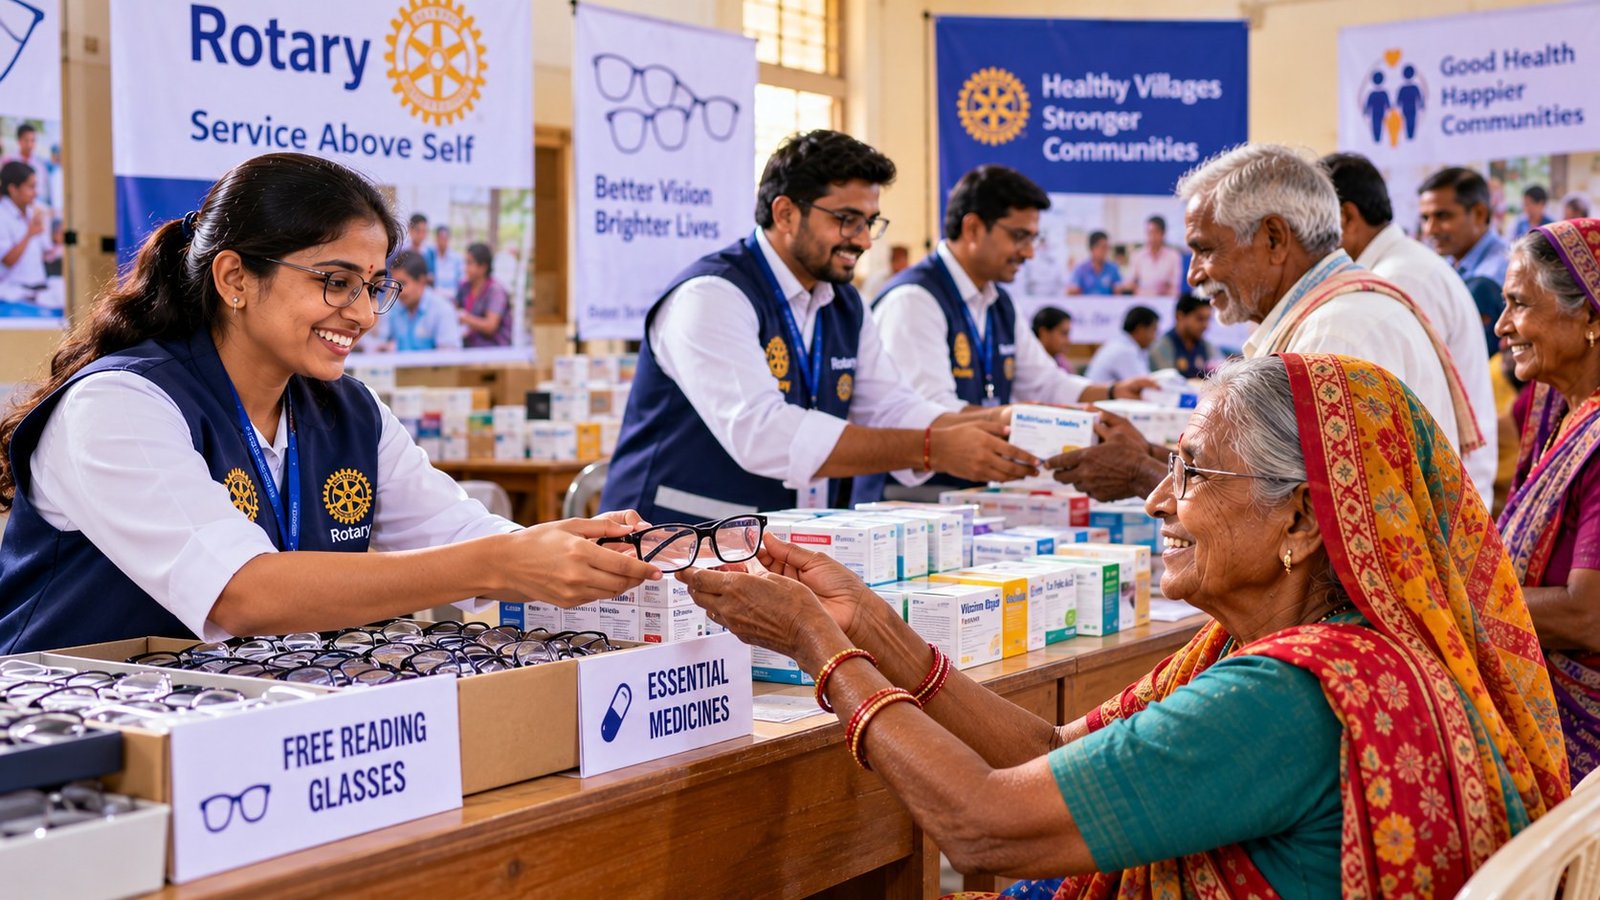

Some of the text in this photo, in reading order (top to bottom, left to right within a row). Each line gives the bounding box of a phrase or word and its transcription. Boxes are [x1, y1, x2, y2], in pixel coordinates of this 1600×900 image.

[190, 3, 371, 90] Rotary
[1440, 41, 1575, 77] Good Health
[1042, 71, 1222, 105] Healthy Villages
[1441, 79, 1525, 111] Happier
[190, 110, 474, 163] Service Above Self
[1042, 105, 1142, 137] Stronger
[1441, 103, 1585, 136] Communities
[1042, 135, 1199, 162] Communities
[595, 174, 713, 205] Better Vision
[595, 210, 720, 242] Brighter Lives
[330, 524, 372, 543] Rotary
[648, 658, 729, 700] ESSENTIAL
[649, 695, 730, 739] MEDICINES
[283, 711, 427, 770] FREE READING
[309, 760, 406, 812] GLASSES
